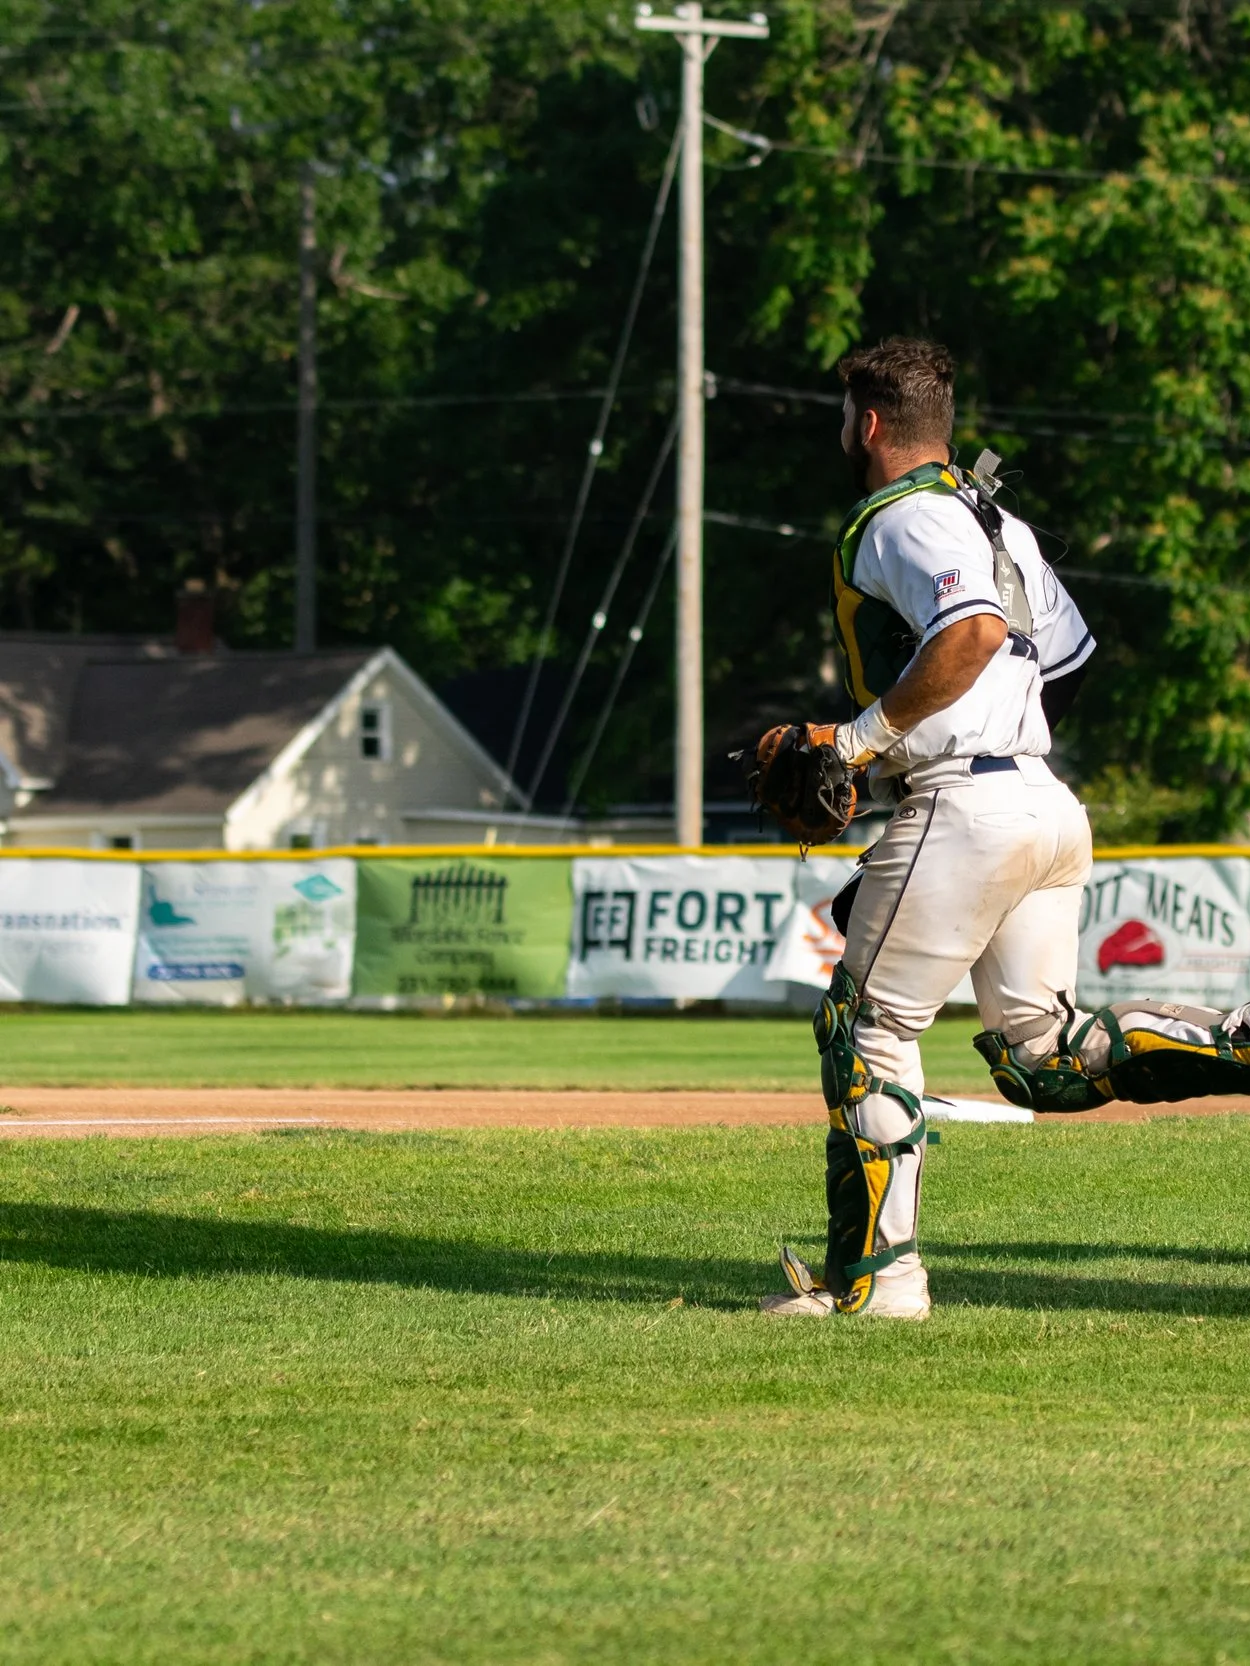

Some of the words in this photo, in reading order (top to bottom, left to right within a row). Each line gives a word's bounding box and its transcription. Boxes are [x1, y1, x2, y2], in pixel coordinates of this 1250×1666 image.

[0, 910, 121, 931] ansnation
[648, 890, 783, 933] FORT
[1147, 871, 1236, 948] MEATS
[643, 938, 776, 965] FREIGHT
